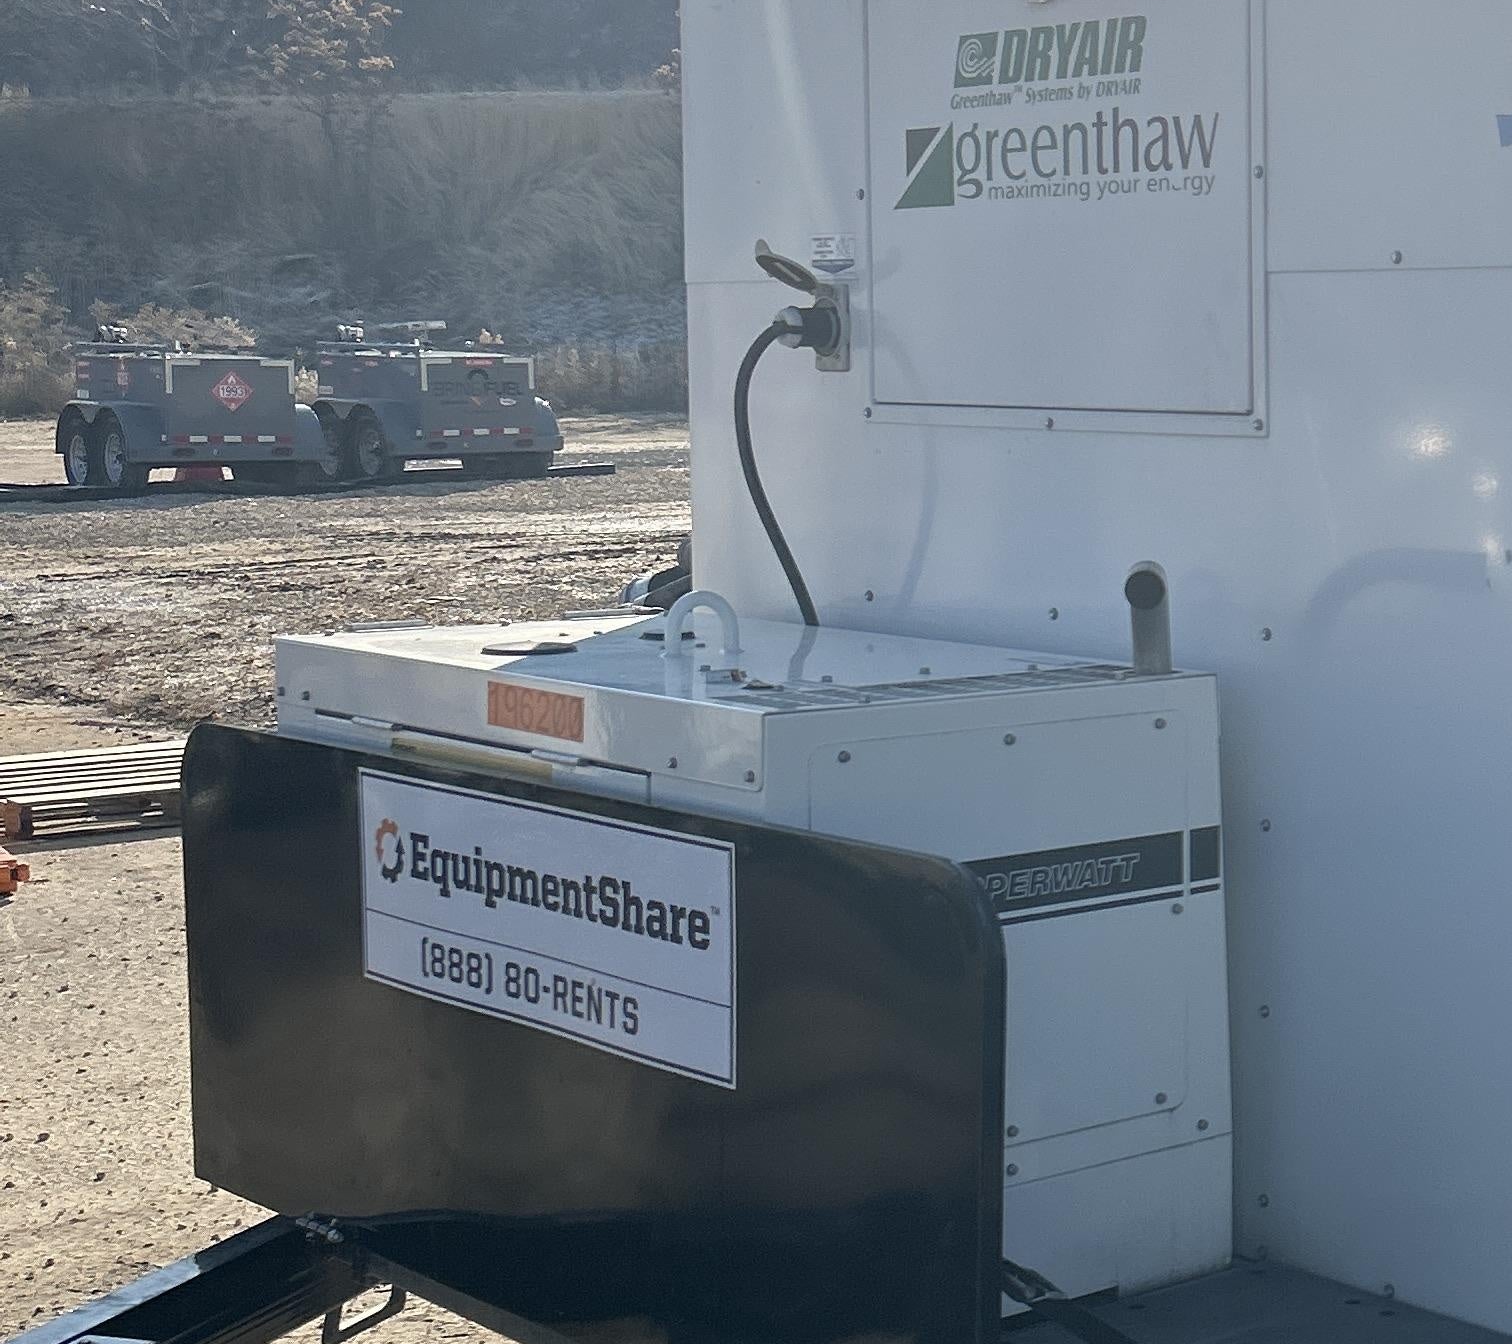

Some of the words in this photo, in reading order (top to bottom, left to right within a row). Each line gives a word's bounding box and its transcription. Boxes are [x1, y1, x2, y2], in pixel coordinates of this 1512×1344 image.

[998, 15, 1147, 84] DRYAIR
[1025, 87, 1074, 106] Systems
[1077, 82, 1094, 101] by
[1096, 78, 1141, 98] DRYAIR
[956, 107, 1219, 199] greenthaw
[988, 178, 1091, 202] maximizing
[1097, 177, 1141, 200] your
[221, 385, 245, 397] 1993
[490, 685, 584, 741] 196200
[409, 832, 711, 951] EquipmentShare
[977, 853, 1140, 901] PERWATT
[421, 937, 493, 994] (888)
[505, 962, 639, 1036] 80-RENTS
